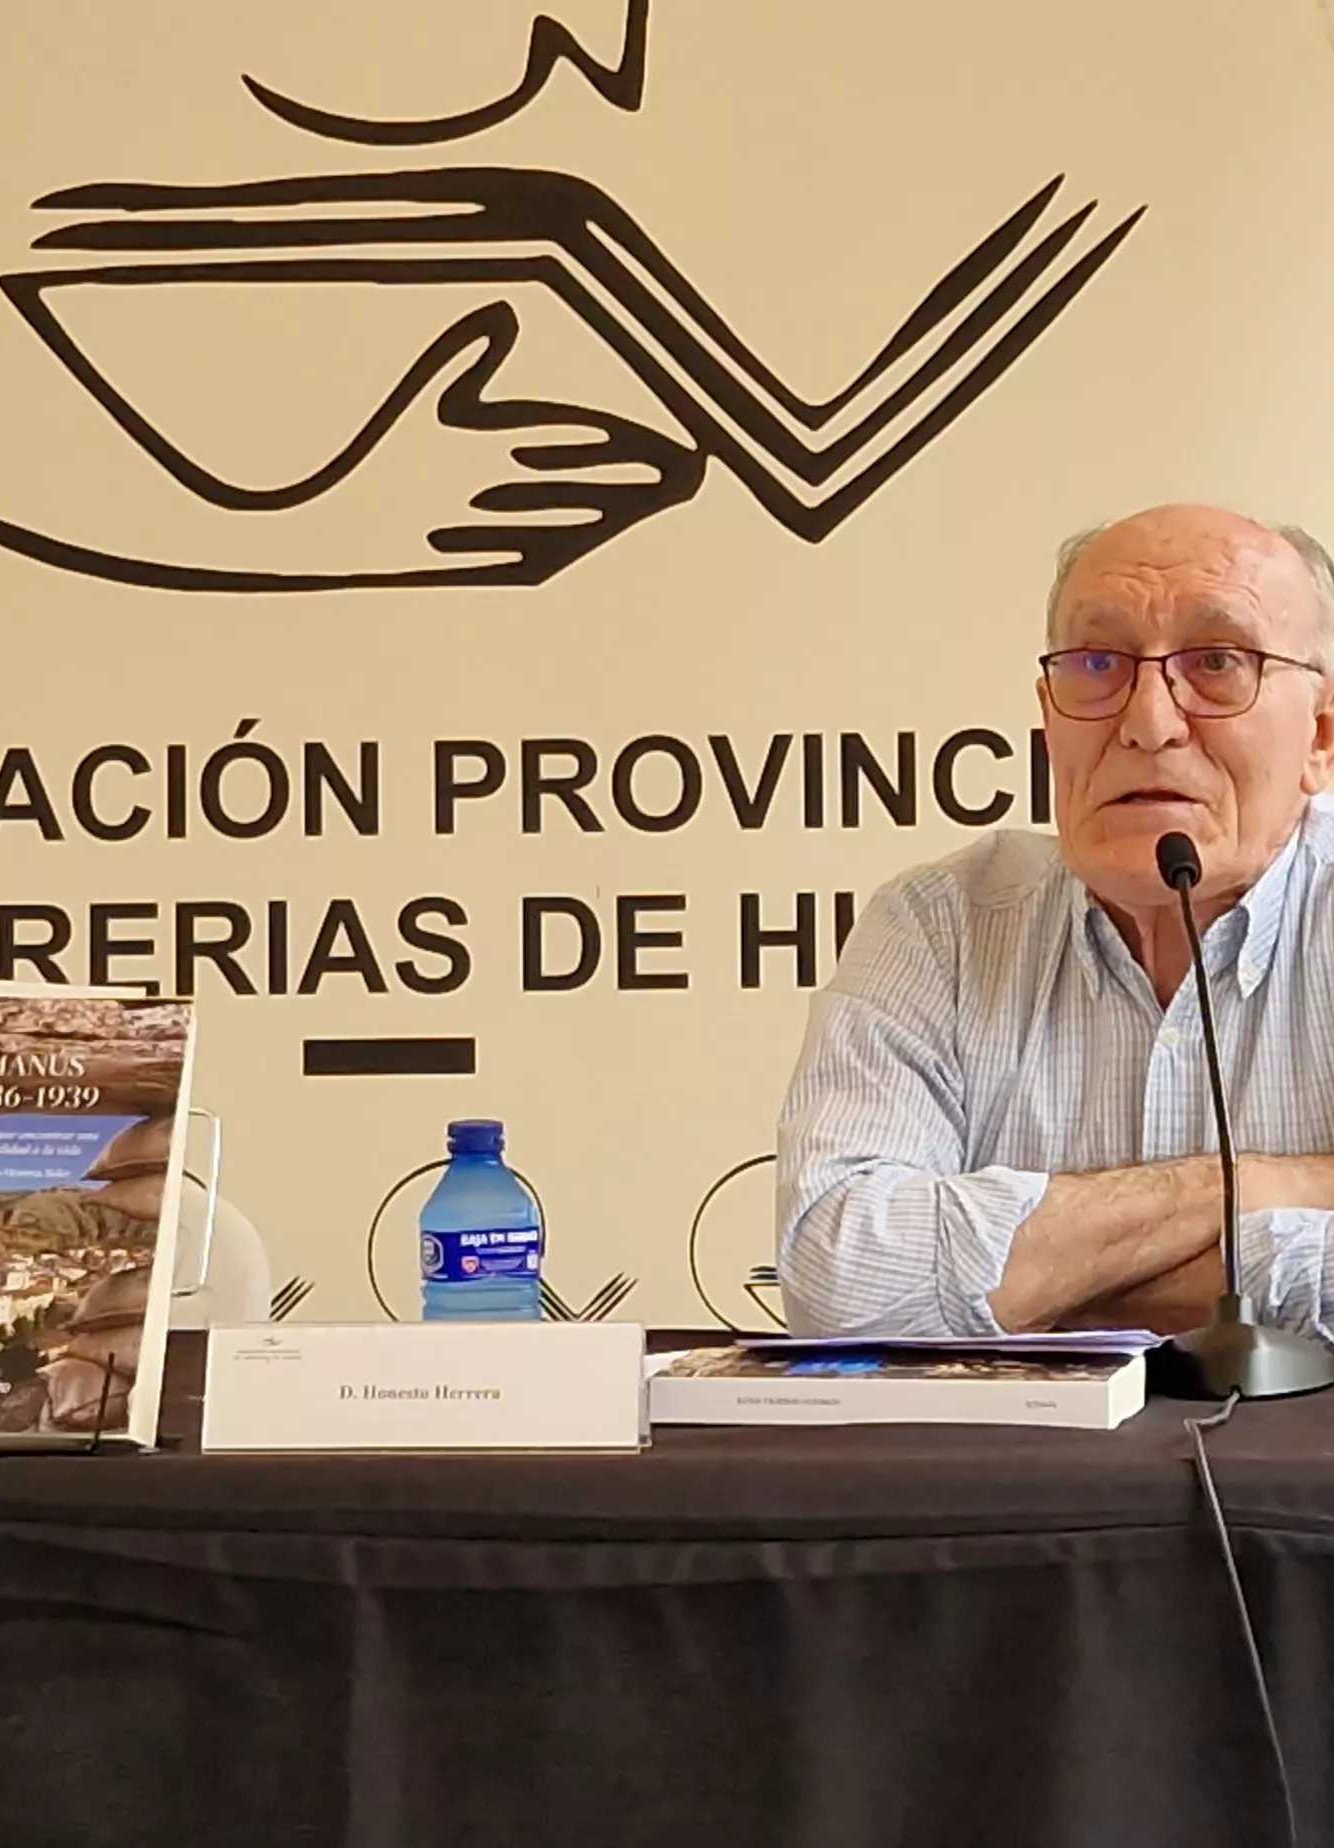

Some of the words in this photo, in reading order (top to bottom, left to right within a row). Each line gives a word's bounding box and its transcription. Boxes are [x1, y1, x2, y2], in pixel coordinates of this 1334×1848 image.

[433, 728, 1054, 834] PROVINCI
[522, 894, 690, 991] DE
[339, 1385, 358, 1400] D.
[363, 1385, 430, 1400] Honesto
[435, 1385, 501, 1400] Herrera
